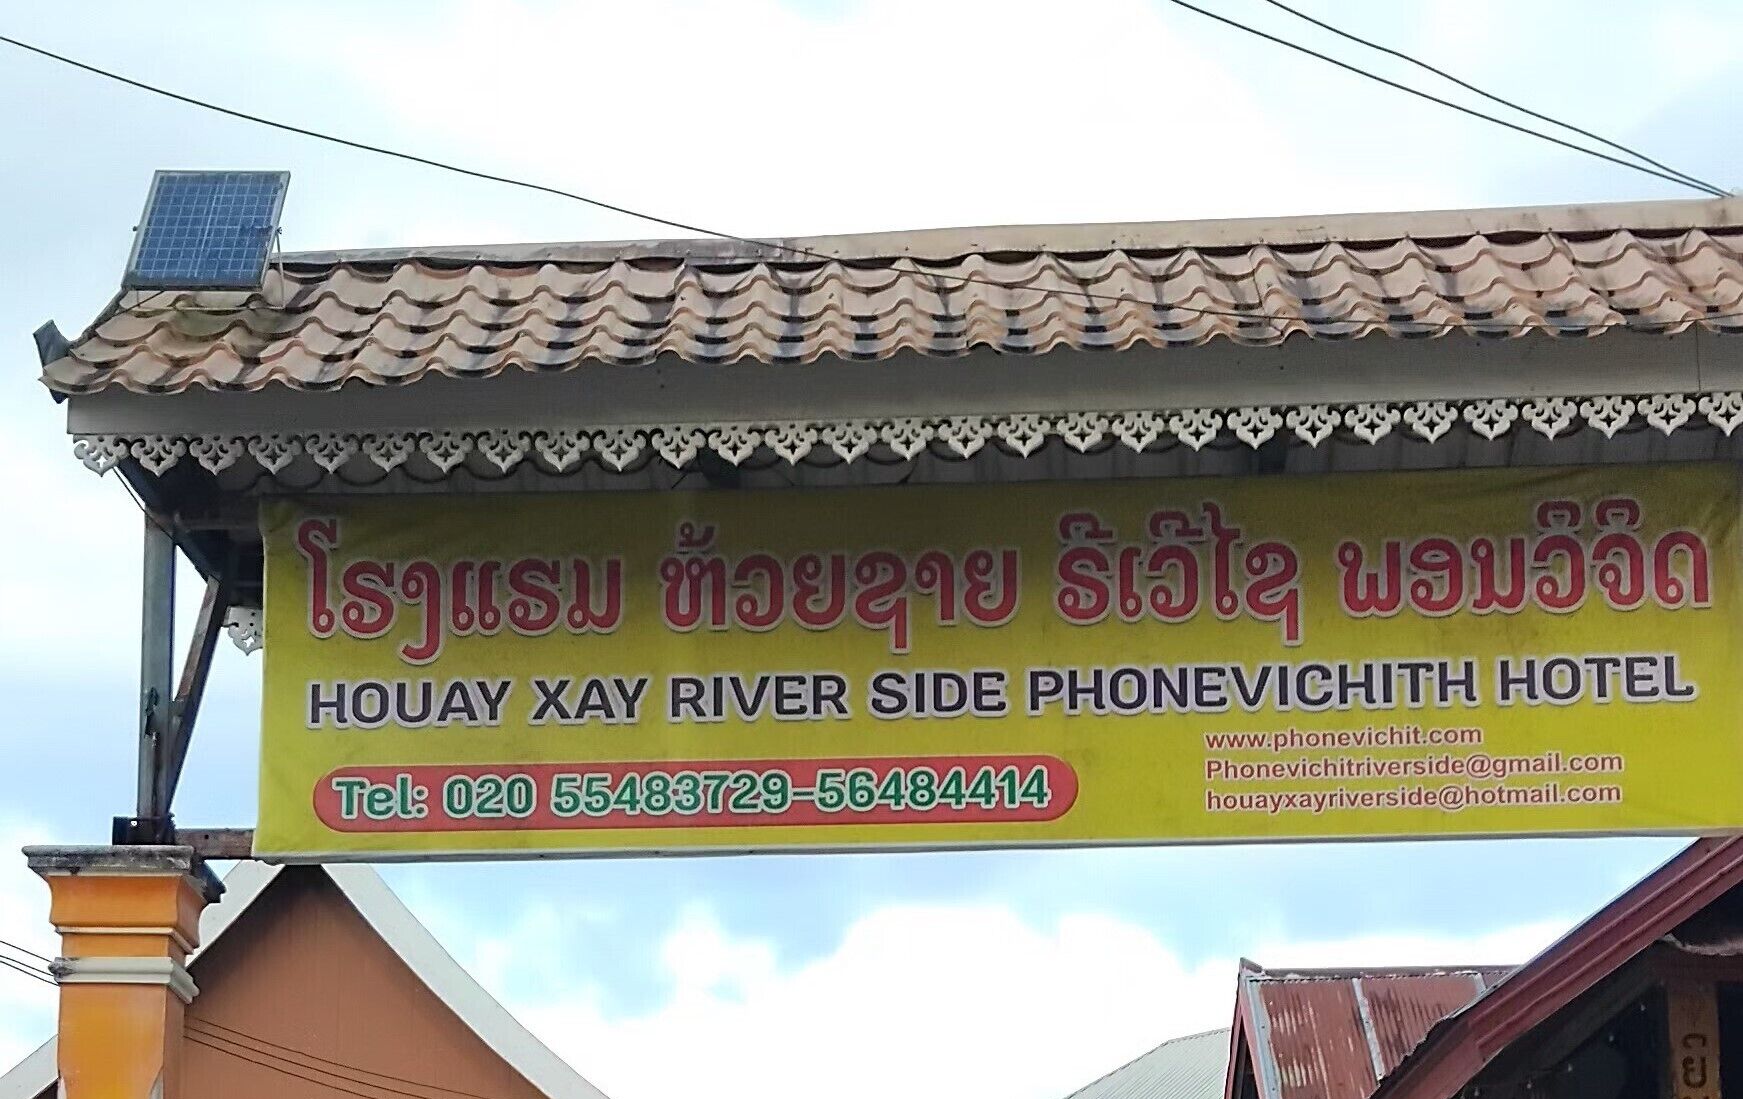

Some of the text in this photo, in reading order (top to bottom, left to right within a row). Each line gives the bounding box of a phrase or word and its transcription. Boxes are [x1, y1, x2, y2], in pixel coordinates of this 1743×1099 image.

[298, 518, 622, 661] ໂຮງແຮມ
[660, 522, 1018, 650] ຫ້ວຍຊາຍ
[1338, 499, 1709, 613] ພອນວິຈິດ
[311, 655, 1695, 725] HOUAY XAY RIVER SIDE PHONEVICHITH HOTEL
[1205, 726, 1482, 752] www.phonevichit.com
[1206, 753, 1623, 779] Phonevichitriverside@gmail.com
[334, 779, 427, 818] Tel:
[445, 777, 534, 815] 020
[1206, 784, 1622, 814] houayxayriverside@hotmail.com
